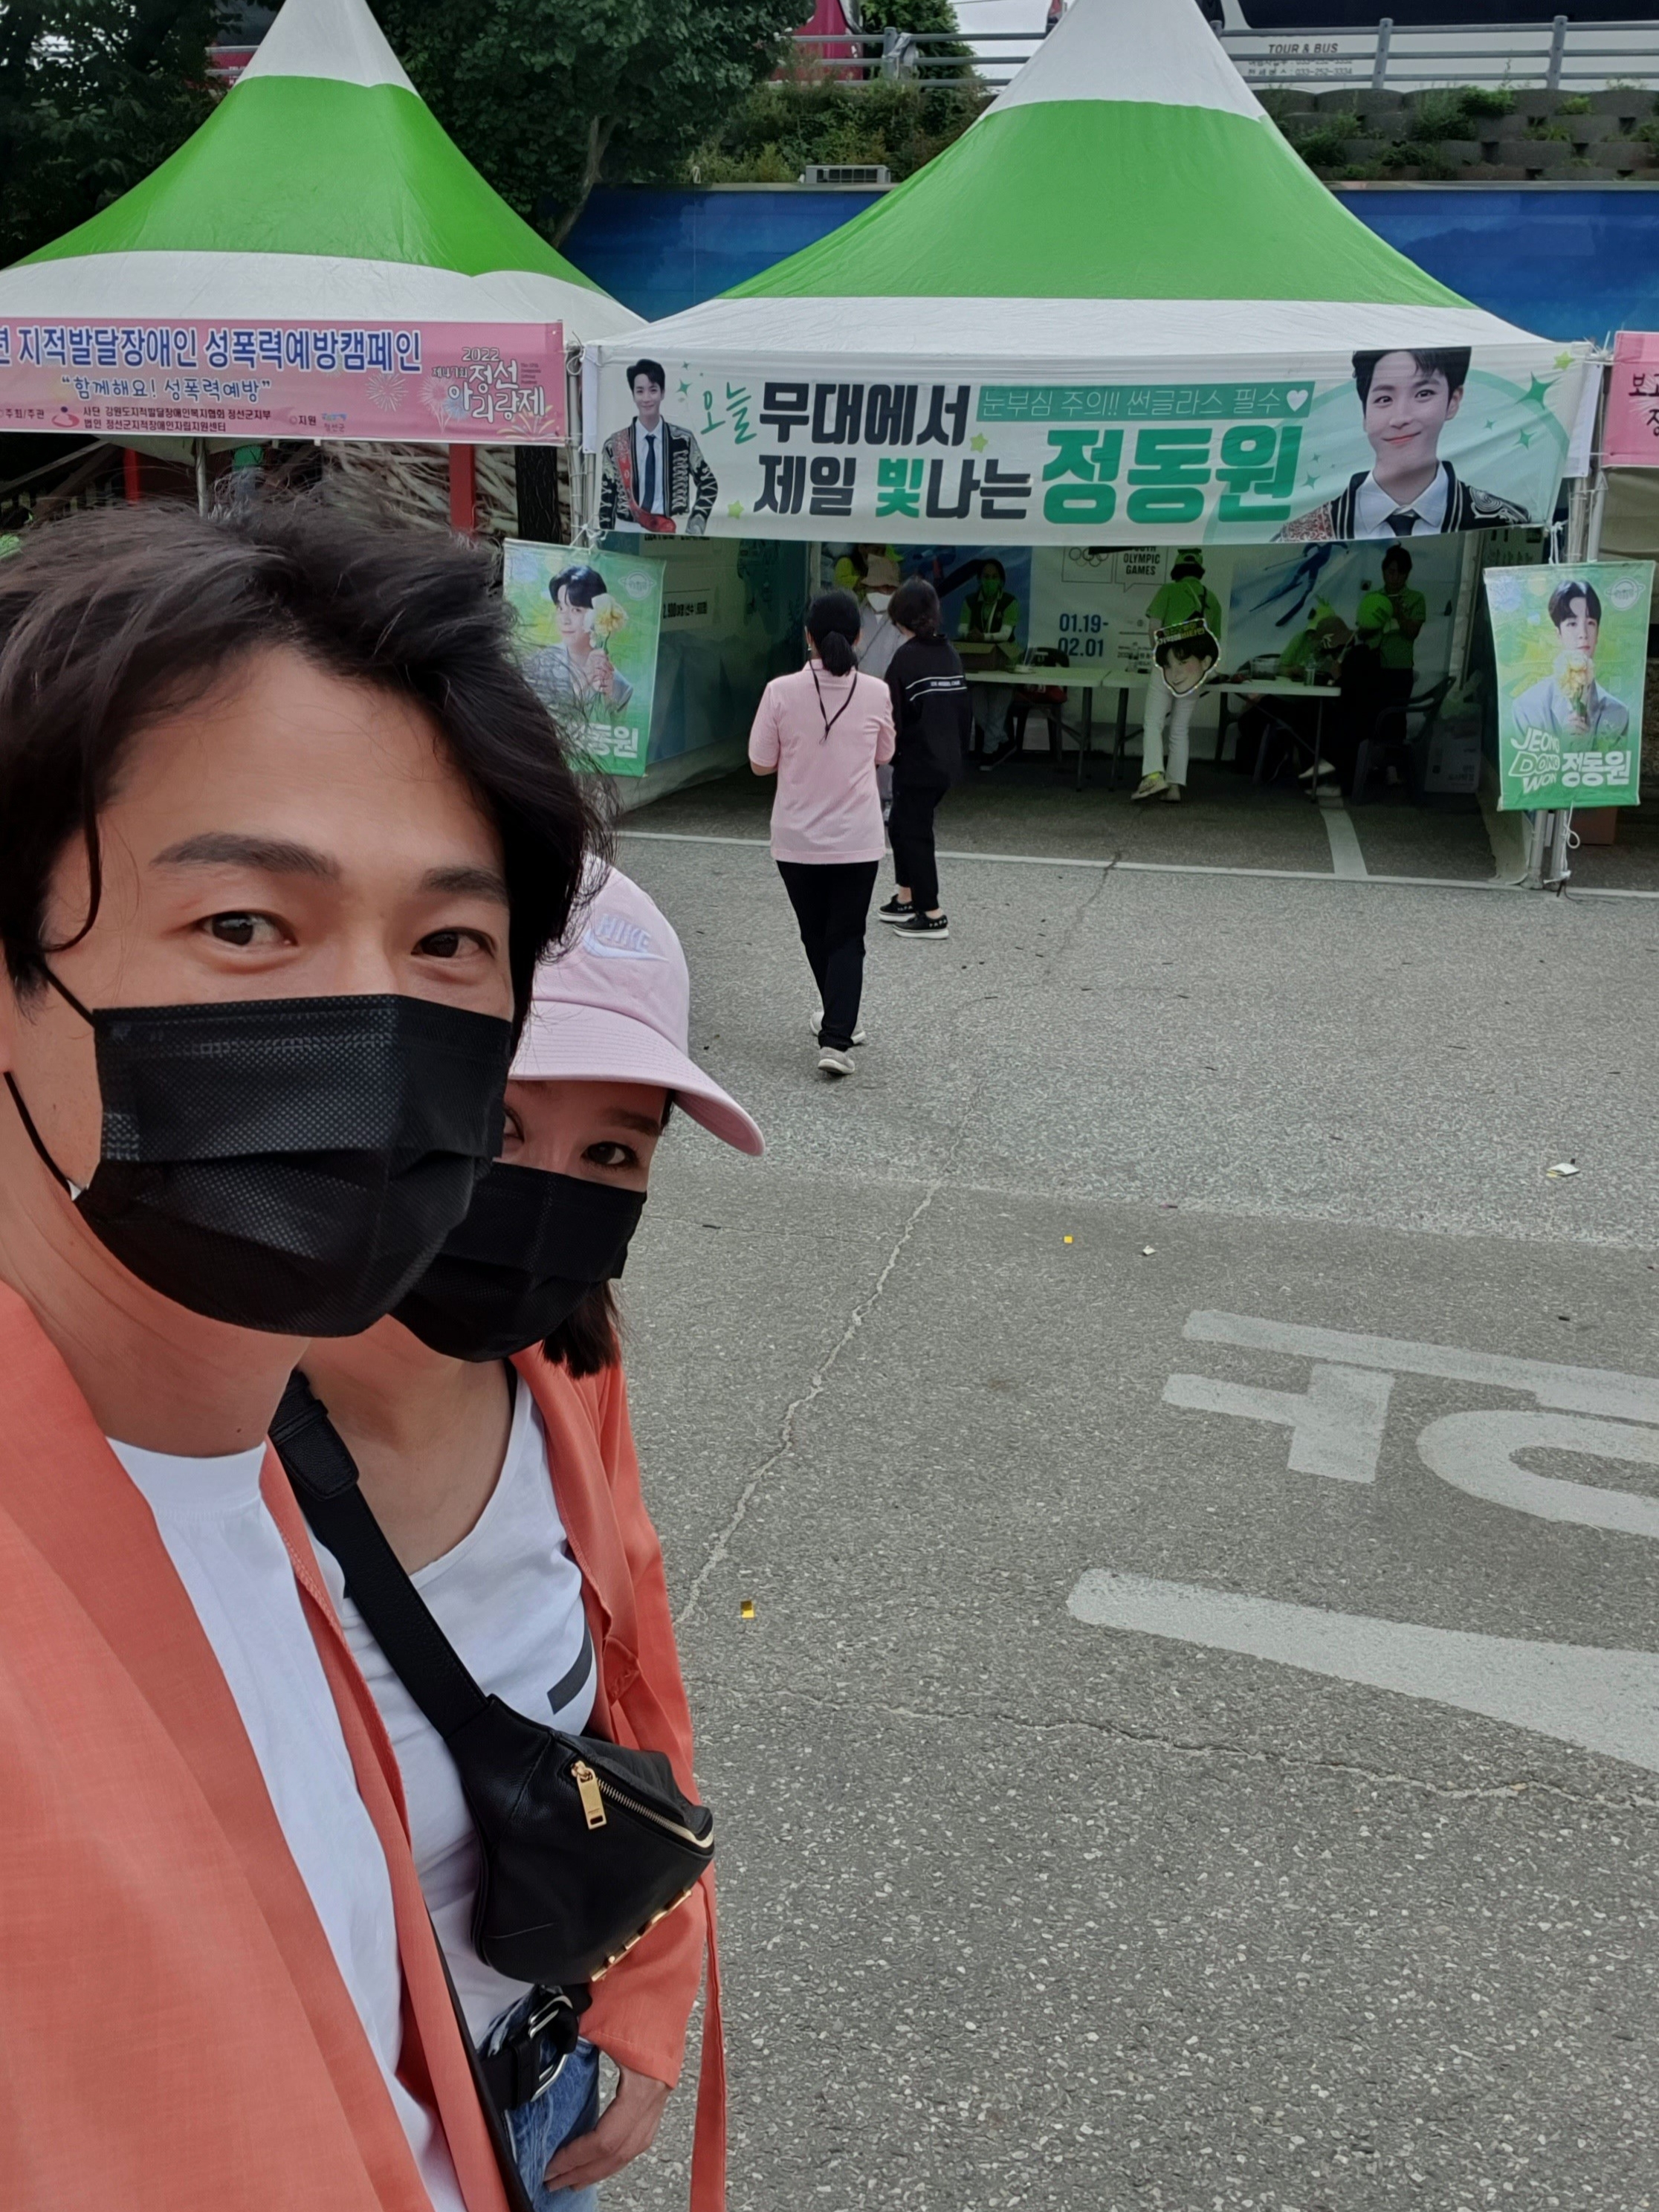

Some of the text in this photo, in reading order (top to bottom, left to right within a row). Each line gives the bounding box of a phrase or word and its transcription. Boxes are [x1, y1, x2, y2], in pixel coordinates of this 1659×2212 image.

[1269, 43, 1338, 54] TOUR & BUS
[18, 327, 197, 367] 지적발달장애인
[205, 330, 421, 372] 성폭력예방캠페인
[462, 348, 499, 361] 2022
[469, 360, 519, 394] 정선
[448, 381, 546, 424] 아리랑제
[700, 381, 758, 444] 오늘
[759, 382, 971, 447] 무대에서
[983, 387, 1281, 417] 눈부심 주의!! 썬글라스 필수
[298, 415, 317, 426] 지원
[753, 454, 1032, 520] 제일 빛나는
[1041, 425, 1303, 523] 정동원
[1123, 552, 1160, 564] OLYMPIC
[1125, 565, 1156, 575] GAMES
[1059, 613, 1108, 633] 01.19-
[1058, 637, 1104, 657] 02.01
[1510, 727, 1559, 753] JEONG
[1508, 751, 1560, 777] DONG
[1562, 751, 1631, 788] 정동원
[1523, 773, 1556, 794] WON
[596, 913, 651, 953] NIKE
